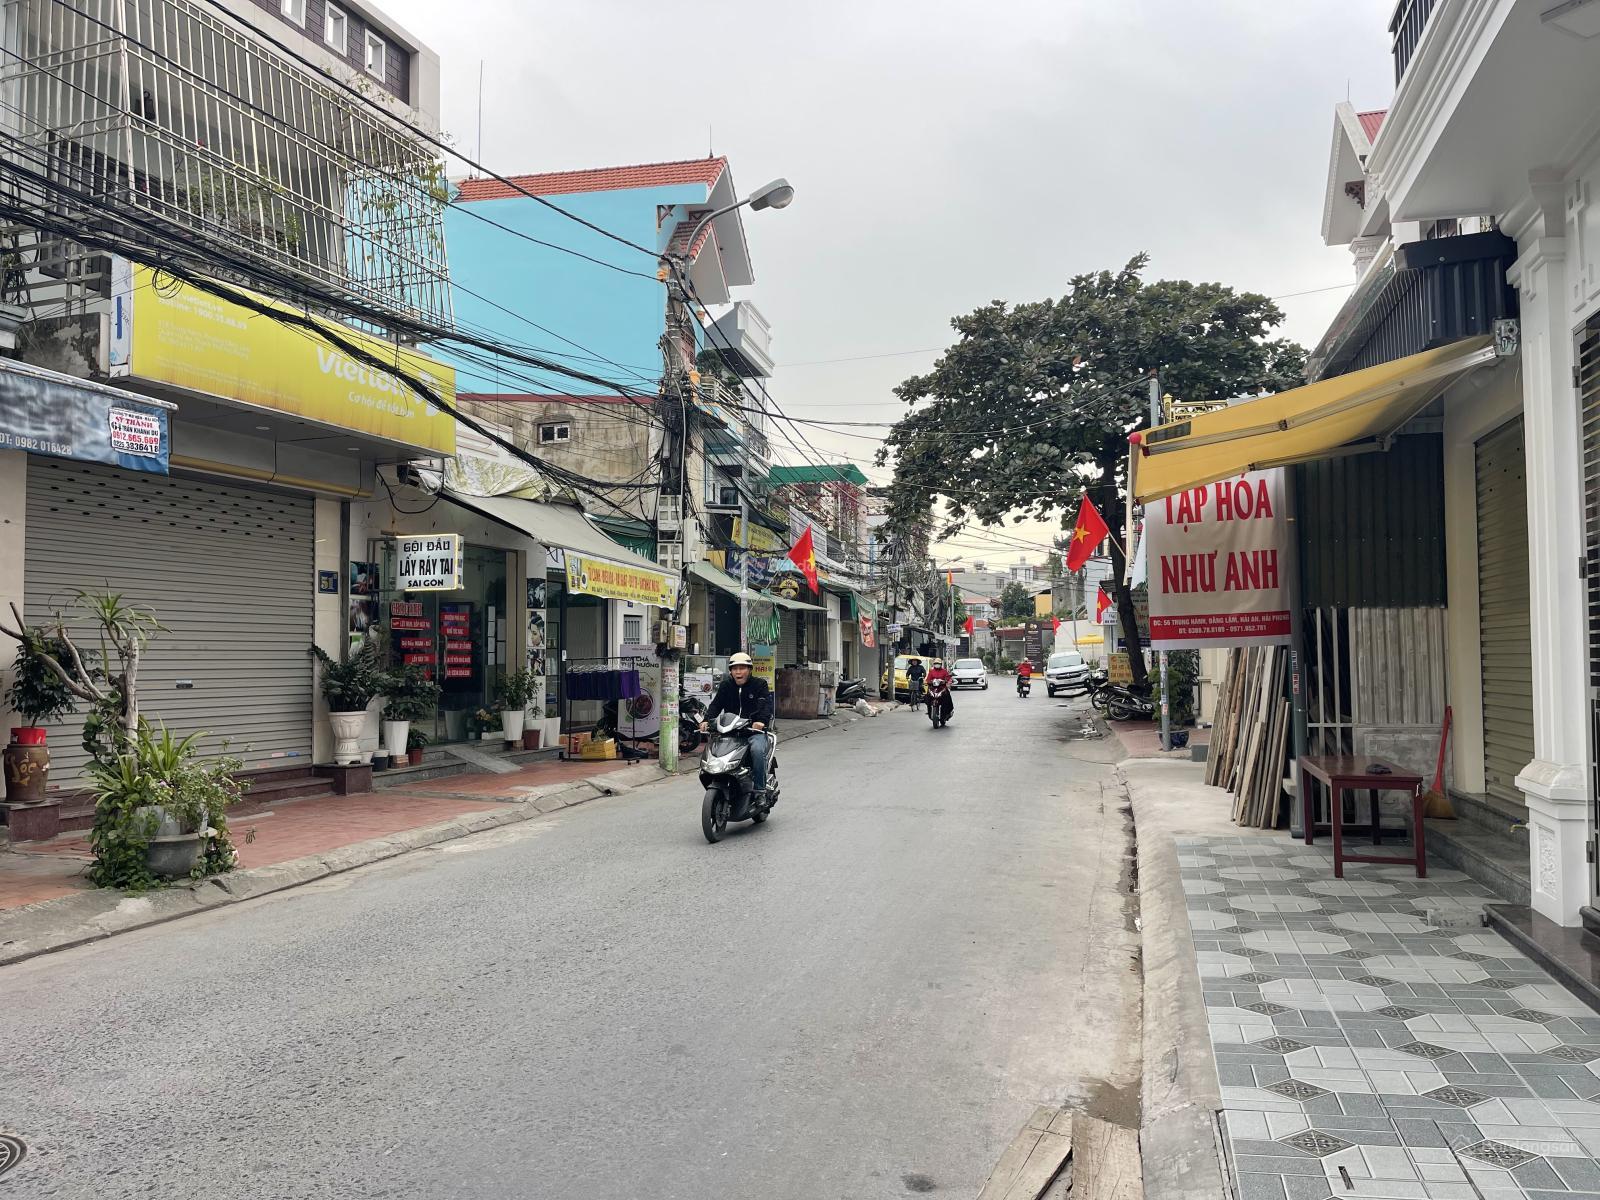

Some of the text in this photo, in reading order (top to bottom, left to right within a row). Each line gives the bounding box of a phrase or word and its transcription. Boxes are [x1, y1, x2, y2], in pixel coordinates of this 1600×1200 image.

[15, 435, 38, 450] 0982
[40, 440, 73, 456] 016428
[1165, 473, 1273, 533] TẠP HÓA
[403, 537, 450, 554] GỘI ĐẦU
[399, 553, 417, 577] LẤY
[419, 555, 437, 576] RÁY
[440, 557, 453, 575] TAI
[1160, 549, 1279, 594] NHƯ ANH
